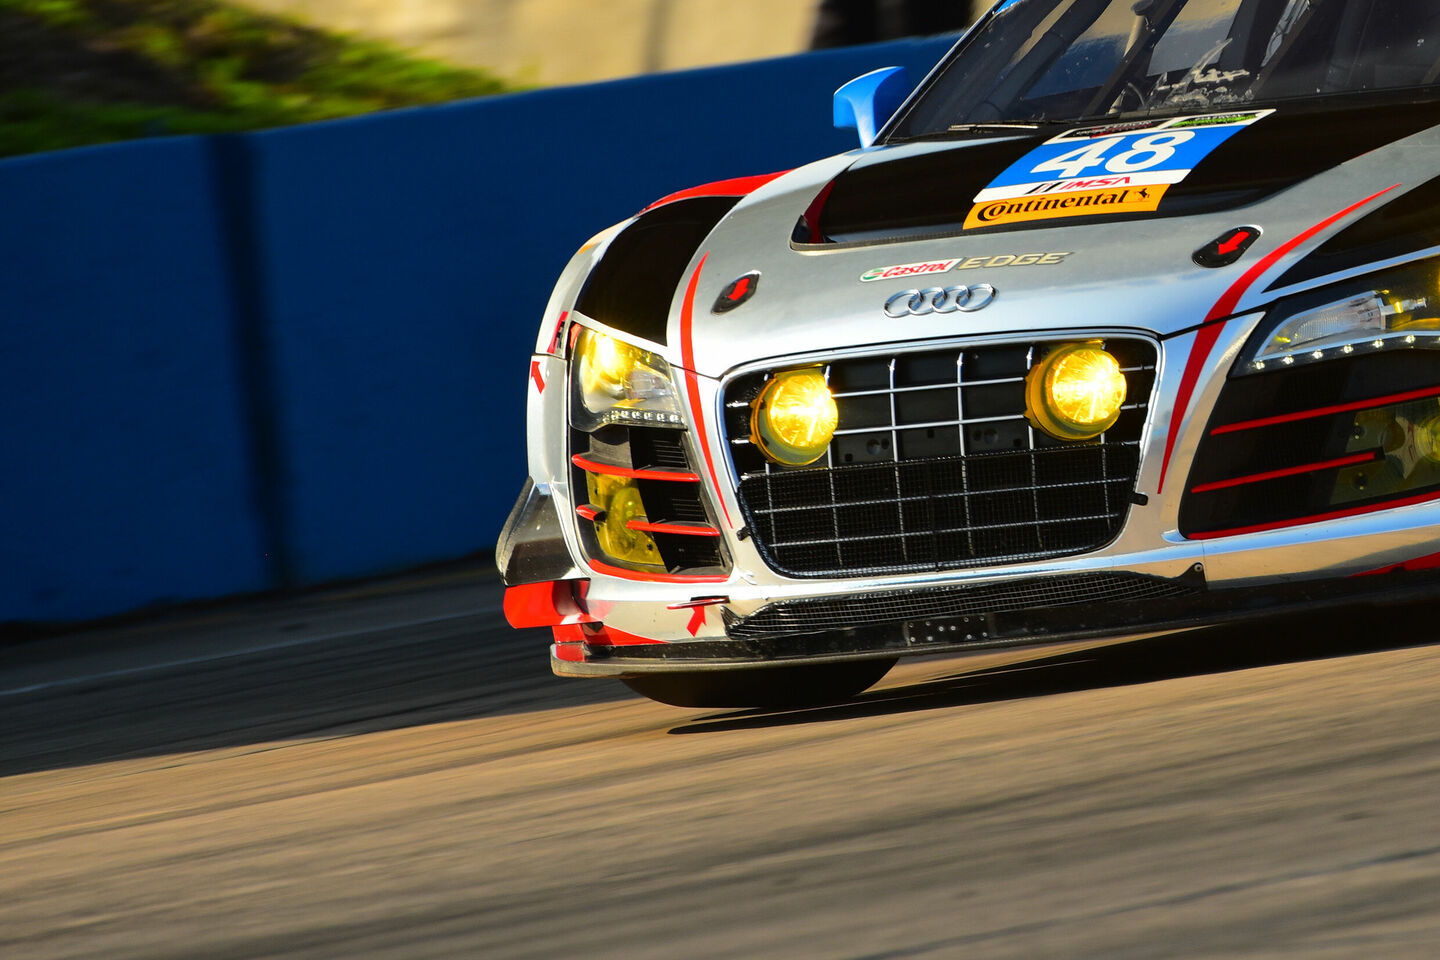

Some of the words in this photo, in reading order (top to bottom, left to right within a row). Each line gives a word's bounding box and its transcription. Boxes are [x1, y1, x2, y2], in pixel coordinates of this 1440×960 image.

[1030, 130, 1196, 178] 48
[1060, 176, 1131, 190] IMSA
[977, 190, 1129, 222] Continental
[882, 260, 953, 278] Castrol
[957, 252, 1074, 270] EDGE
